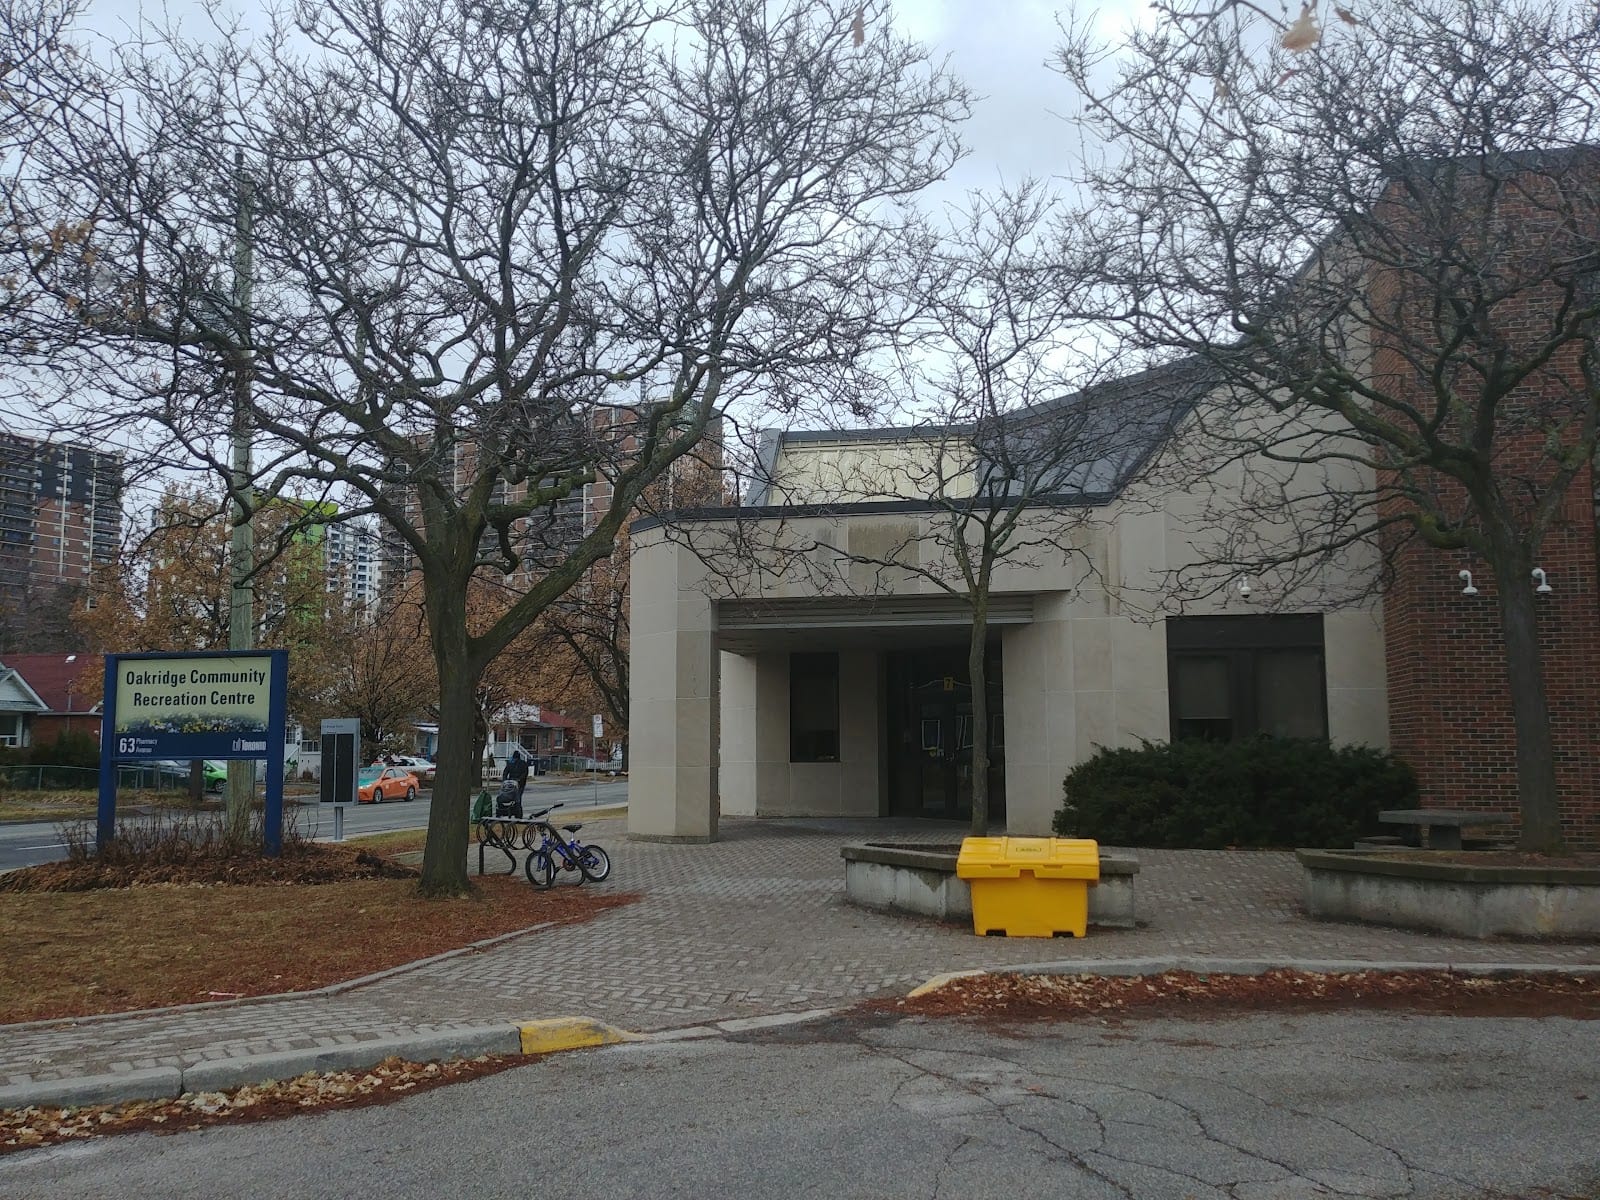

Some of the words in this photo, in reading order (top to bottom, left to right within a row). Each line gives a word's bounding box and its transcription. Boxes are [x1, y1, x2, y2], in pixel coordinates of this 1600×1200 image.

[126, 671, 186, 687] Oakridge
[190, 669, 266, 685] Community
[134, 692, 207, 707] Recreation
[211, 691, 255, 705] Centre
[119, 737, 135, 753] 63
